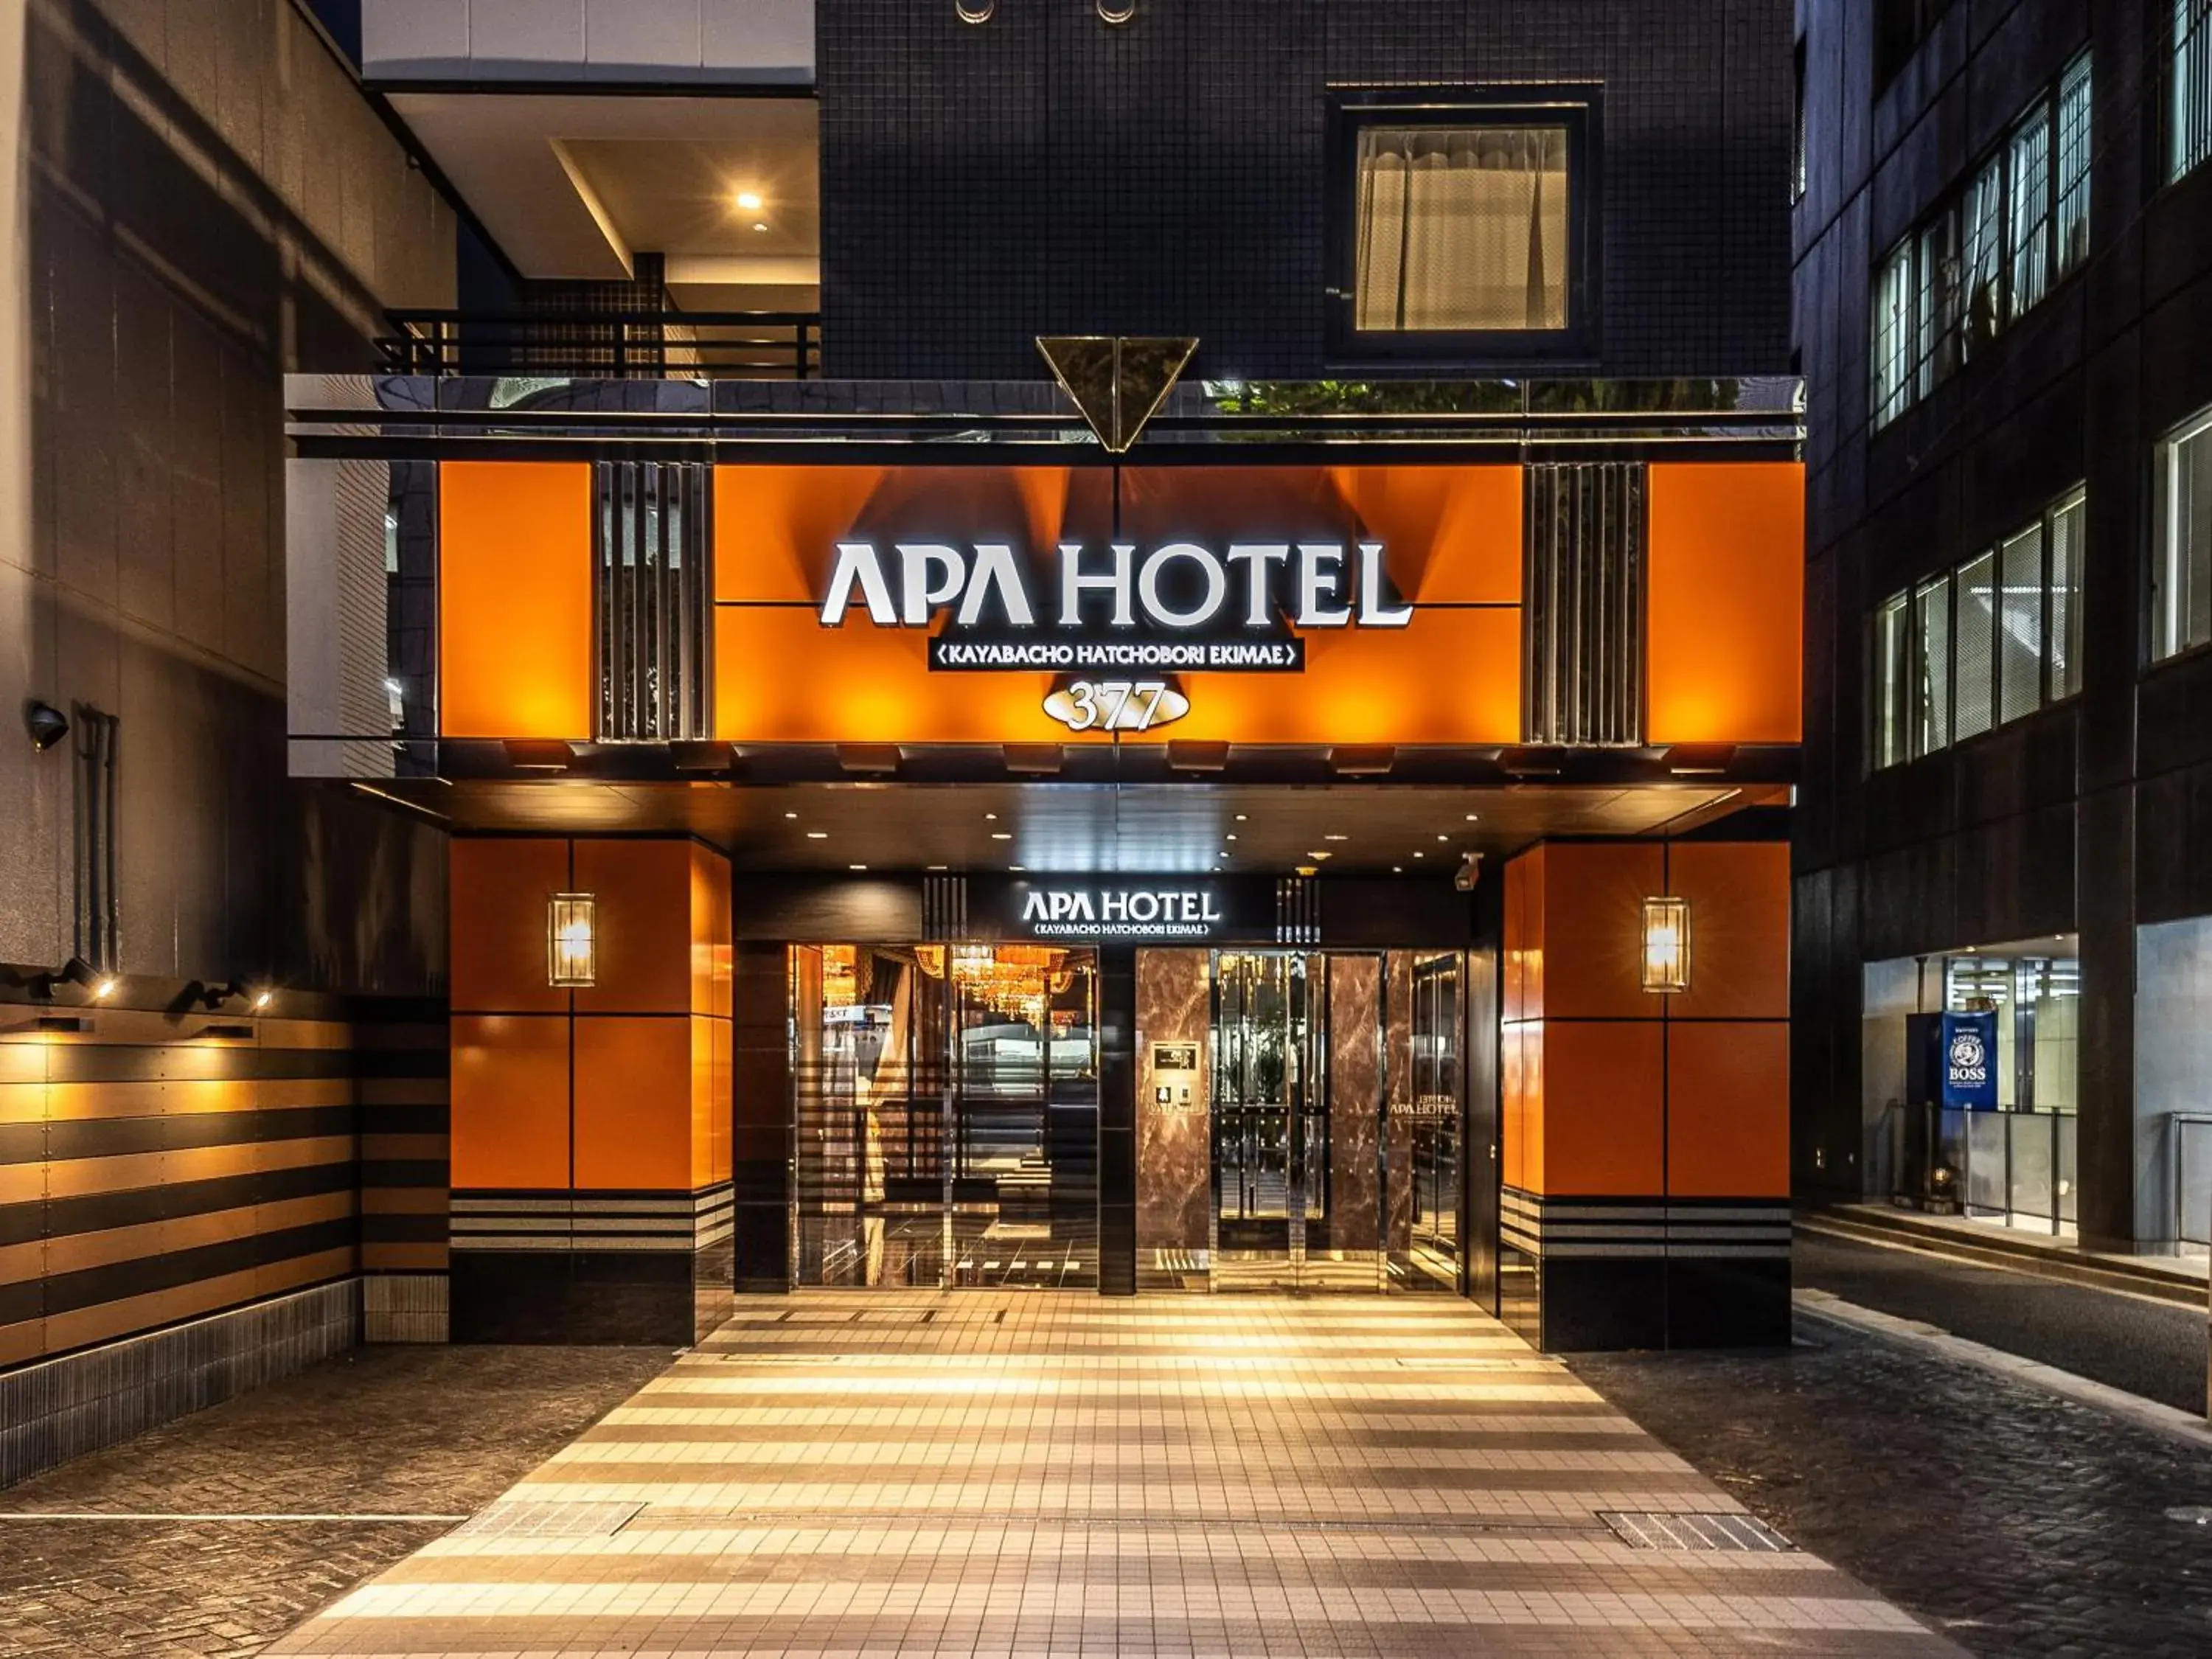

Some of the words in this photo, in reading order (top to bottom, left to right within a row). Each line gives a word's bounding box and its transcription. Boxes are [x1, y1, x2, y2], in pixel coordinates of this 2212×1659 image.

[820, 543, 1035, 627] APA
[1058, 543, 1414, 627] HOTEL
[1077, 644, 1205, 665] HATCHOBORI
[1067, 680, 1166, 731] 377
[1022, 891, 1096, 921] APA
[1101, 891, 1221, 922] HOTEL
[1949, 1068, 1986, 1080] BOSS
[1390, 1104, 1415, 1114] APA
[1416, 1104, 1459, 1114] HOTEL
